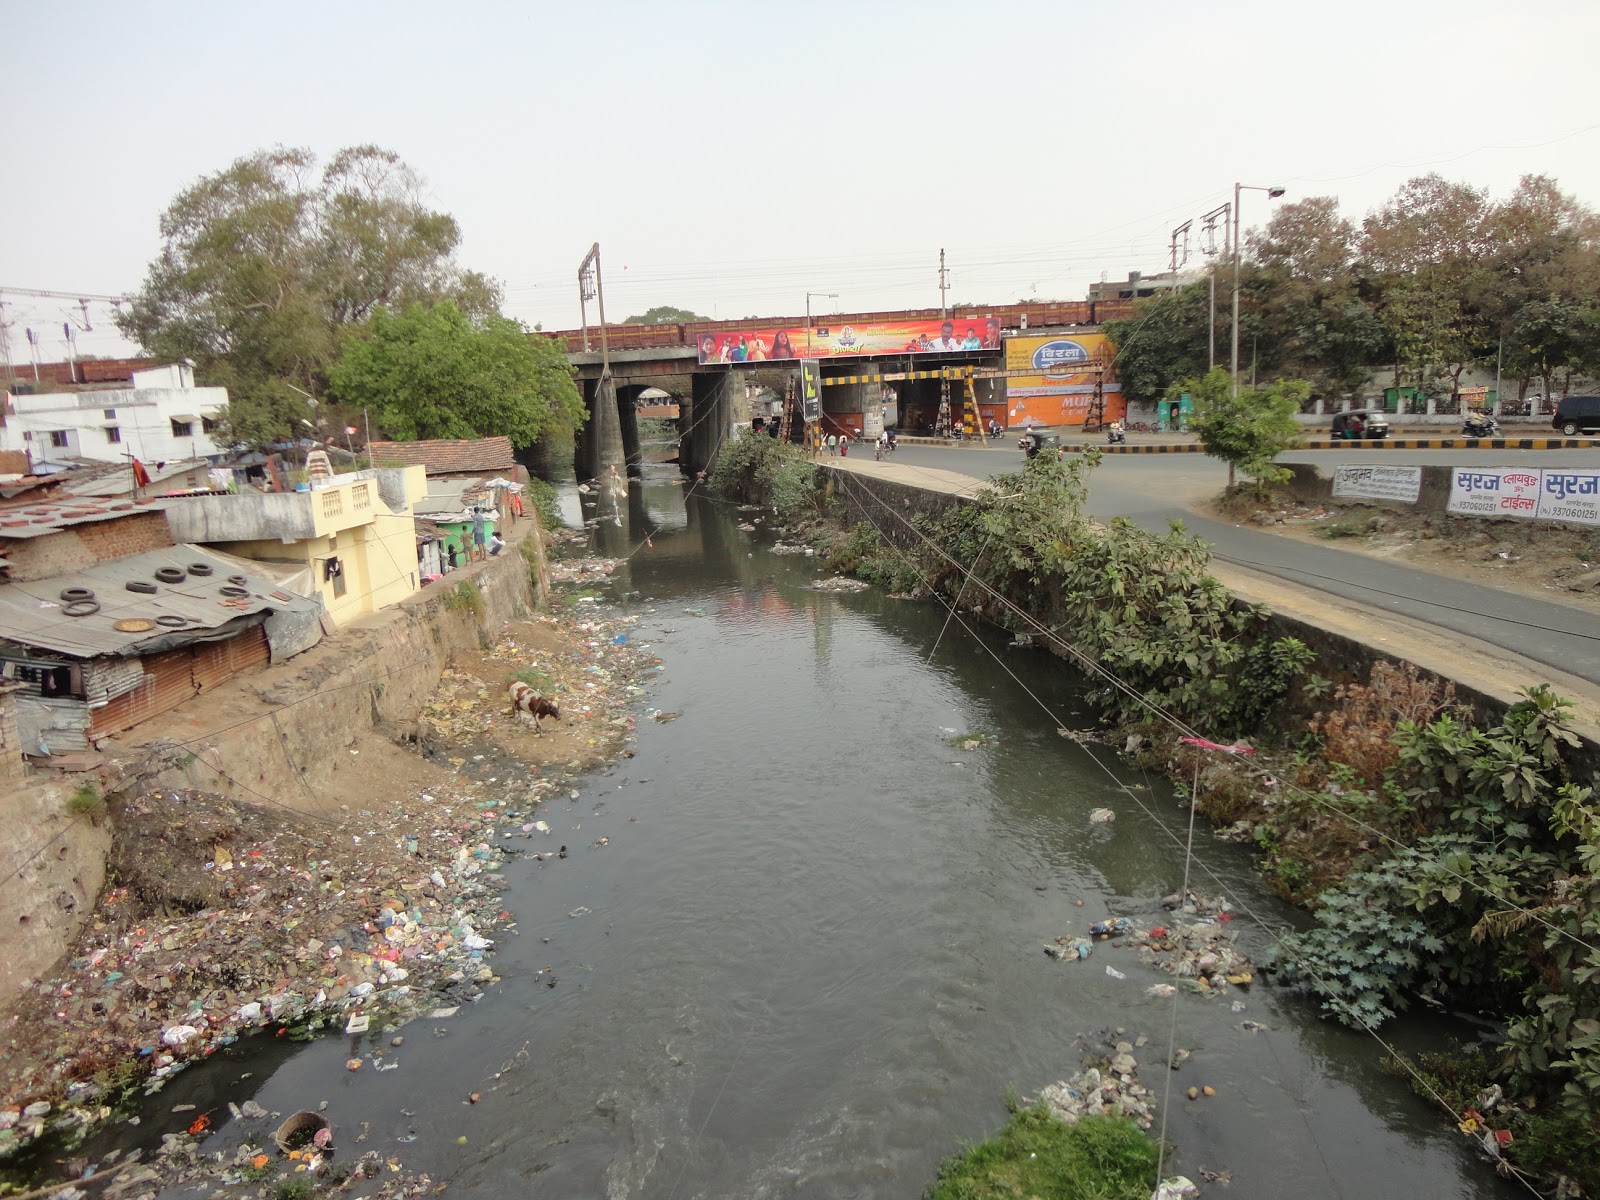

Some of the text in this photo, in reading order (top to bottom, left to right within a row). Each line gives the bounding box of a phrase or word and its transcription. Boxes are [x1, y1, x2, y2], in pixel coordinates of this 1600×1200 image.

[1041, 347, 1080, 358] बिरला
[1062, 396, 1107, 407] MURI
[1342, 468, 1373, 484] अनुभव
[1457, 472, 1501, 492] सुरज
[1503, 473, 1538, 487] प्लायवुड
[1546, 474, 1599, 500] सुरज
[1459, 501, 1497, 512] 9370601251
[1501, 494, 1536, 510] टाईल्स
[1552, 506, 1598, 519] 9370601251
